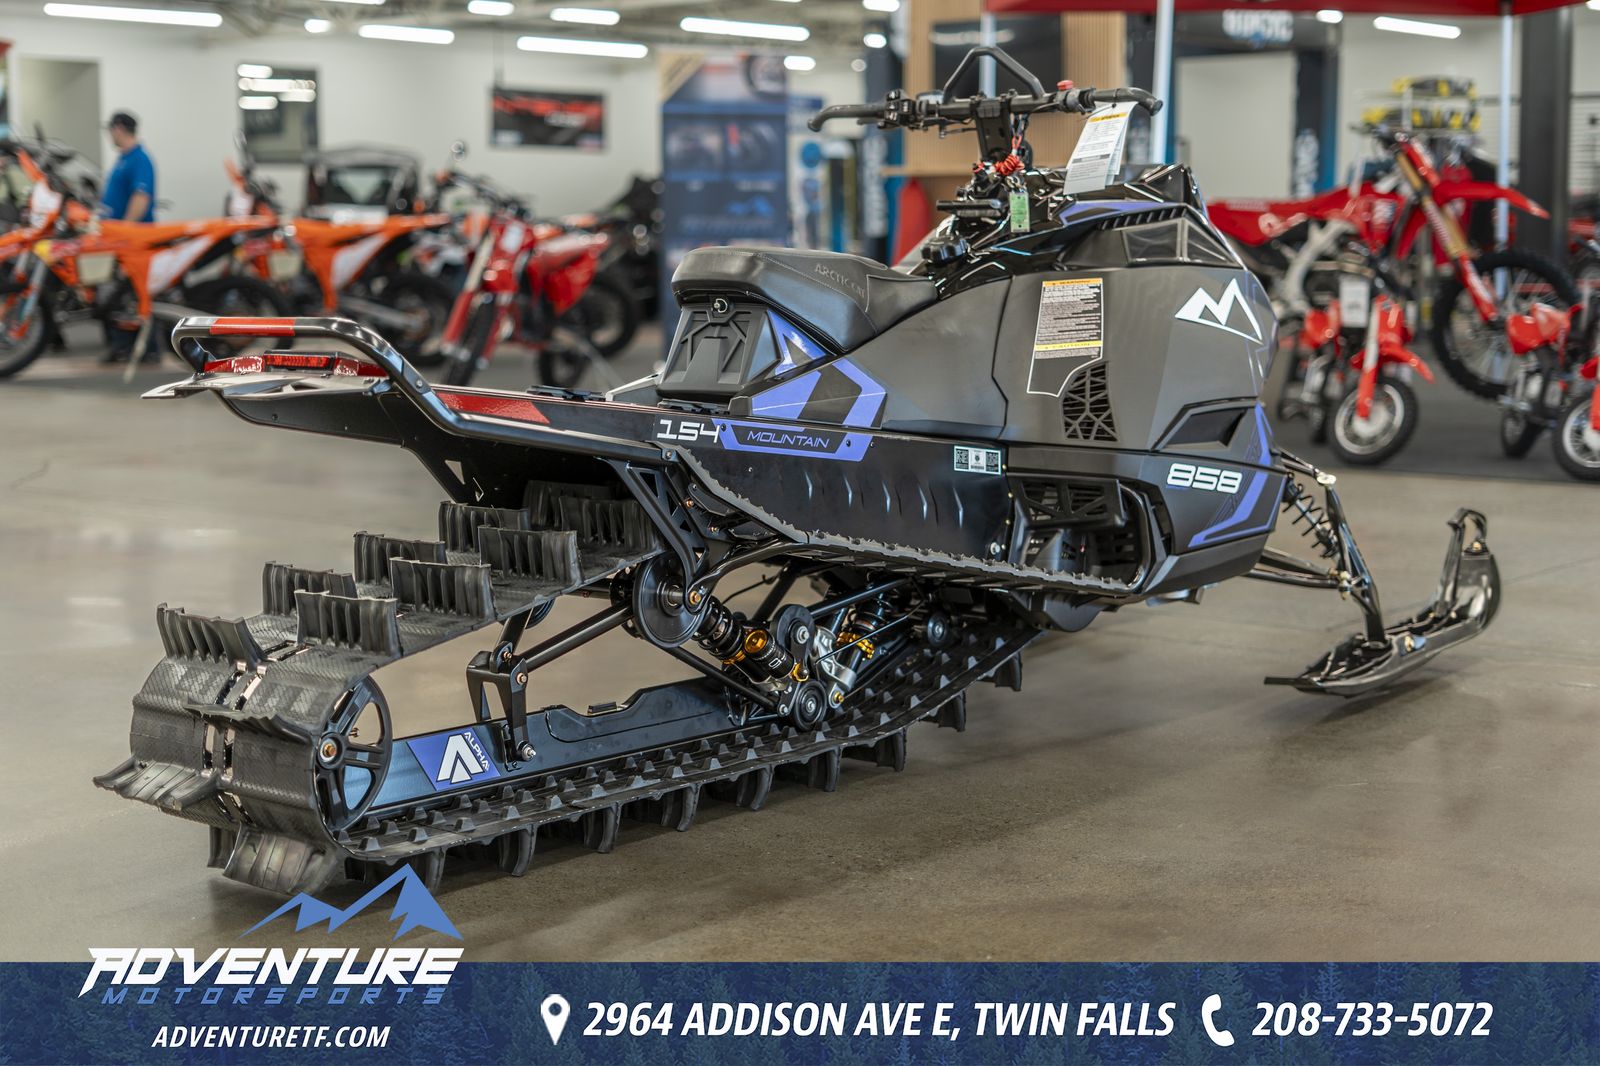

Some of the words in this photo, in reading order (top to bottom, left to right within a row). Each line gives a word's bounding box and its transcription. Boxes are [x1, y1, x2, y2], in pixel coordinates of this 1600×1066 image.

[815, 263, 849, 288] ARCTIC
[656, 419, 721, 444] 154
[746, 429, 831, 448] MOUNTAIN
[1166, 462, 1243, 495] 858
[464, 731, 490, 771] ALPHA
